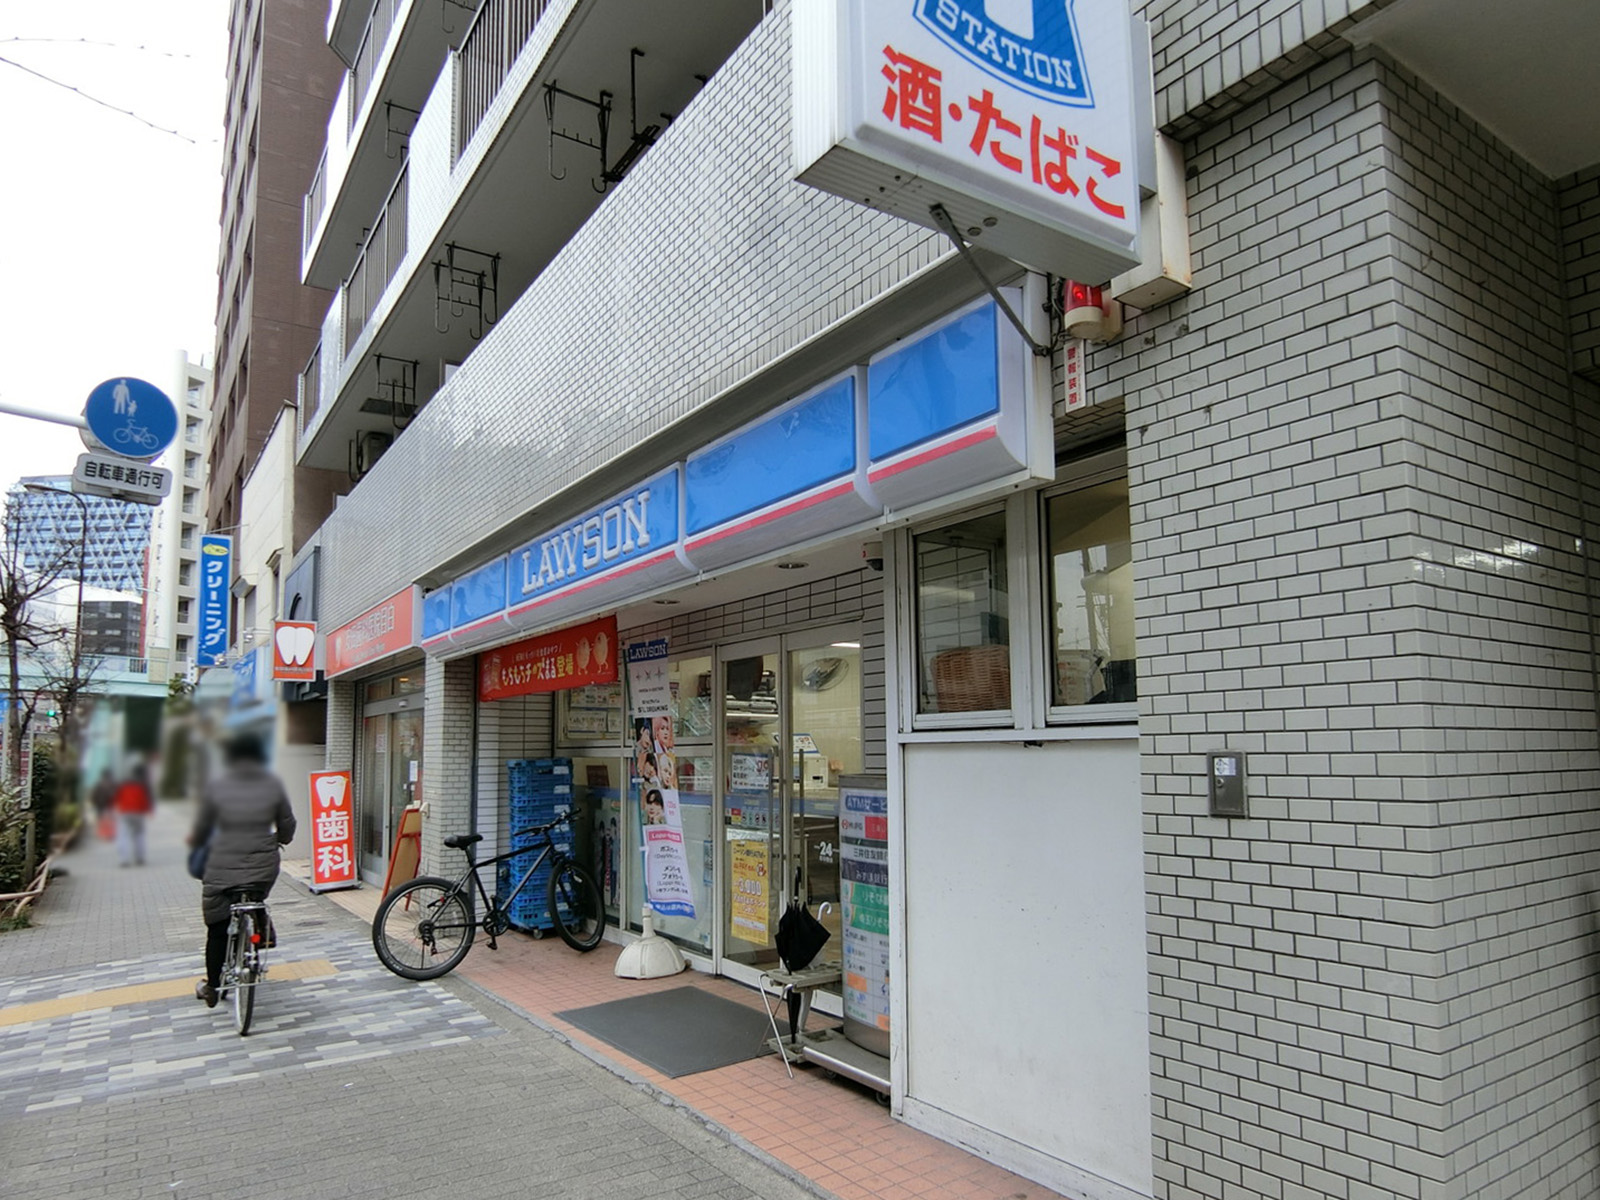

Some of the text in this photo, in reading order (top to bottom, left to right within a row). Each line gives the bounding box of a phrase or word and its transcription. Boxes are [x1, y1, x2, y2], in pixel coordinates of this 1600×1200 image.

[935, 0, 1077, 90] STATION
[881, 45, 1126, 220] 酒・たばこ
[1067, 346, 1077, 405] 警報装置
[84, 460, 164, 489] 自転車通行可
[521, 489, 651, 595] LAWSON
[204, 560, 226, 646] クリーニング
[629, 644, 667, 660] LAWSON
[316, 810, 352, 879] 歯科
[819, 841, 833, 857] 24
